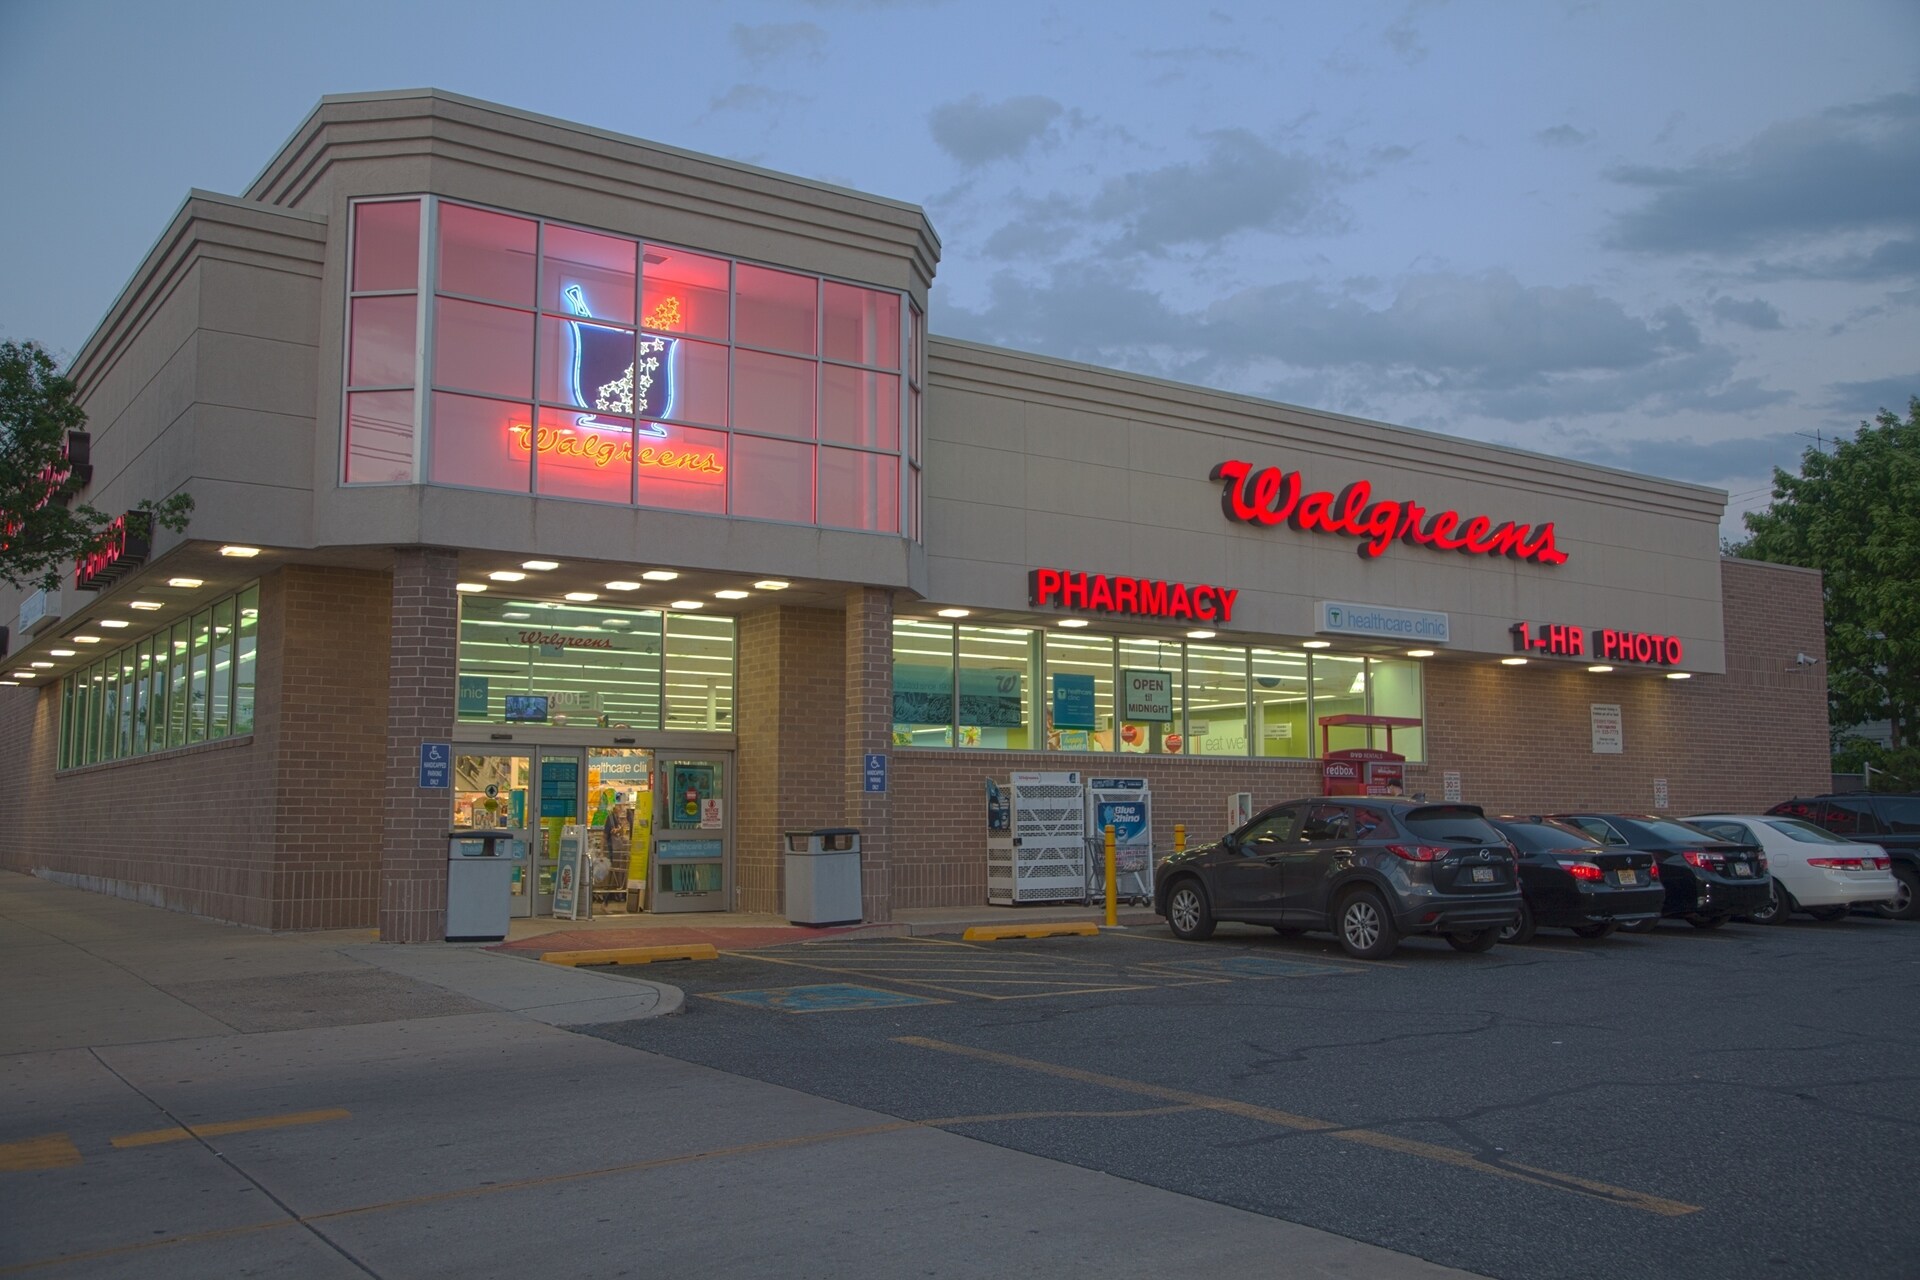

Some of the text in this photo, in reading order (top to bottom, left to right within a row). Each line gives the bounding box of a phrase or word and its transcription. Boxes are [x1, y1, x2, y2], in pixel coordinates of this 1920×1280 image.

[515, 424, 724, 473] Walgreens
[1211, 460, 1569, 565] Walgreens
[1032, 568, 1239, 623] PHARMACY
[1348, 610, 1446, 635] healthcare clinic
[518, 631, 613, 650] Walgreens
[1513, 621, 1683, 665] 1-HR PHOTO
[1133, 678, 1164, 691] OPEN
[1145, 692, 1153, 702] til
[1128, 704, 1169, 715] MIDNIGHT
[1205, 736, 1224, 751] eat
[1326, 765, 1354, 775] redbox
[1114, 806, 1135, 814] Blue
[1113, 814, 1140, 823] Rhino
